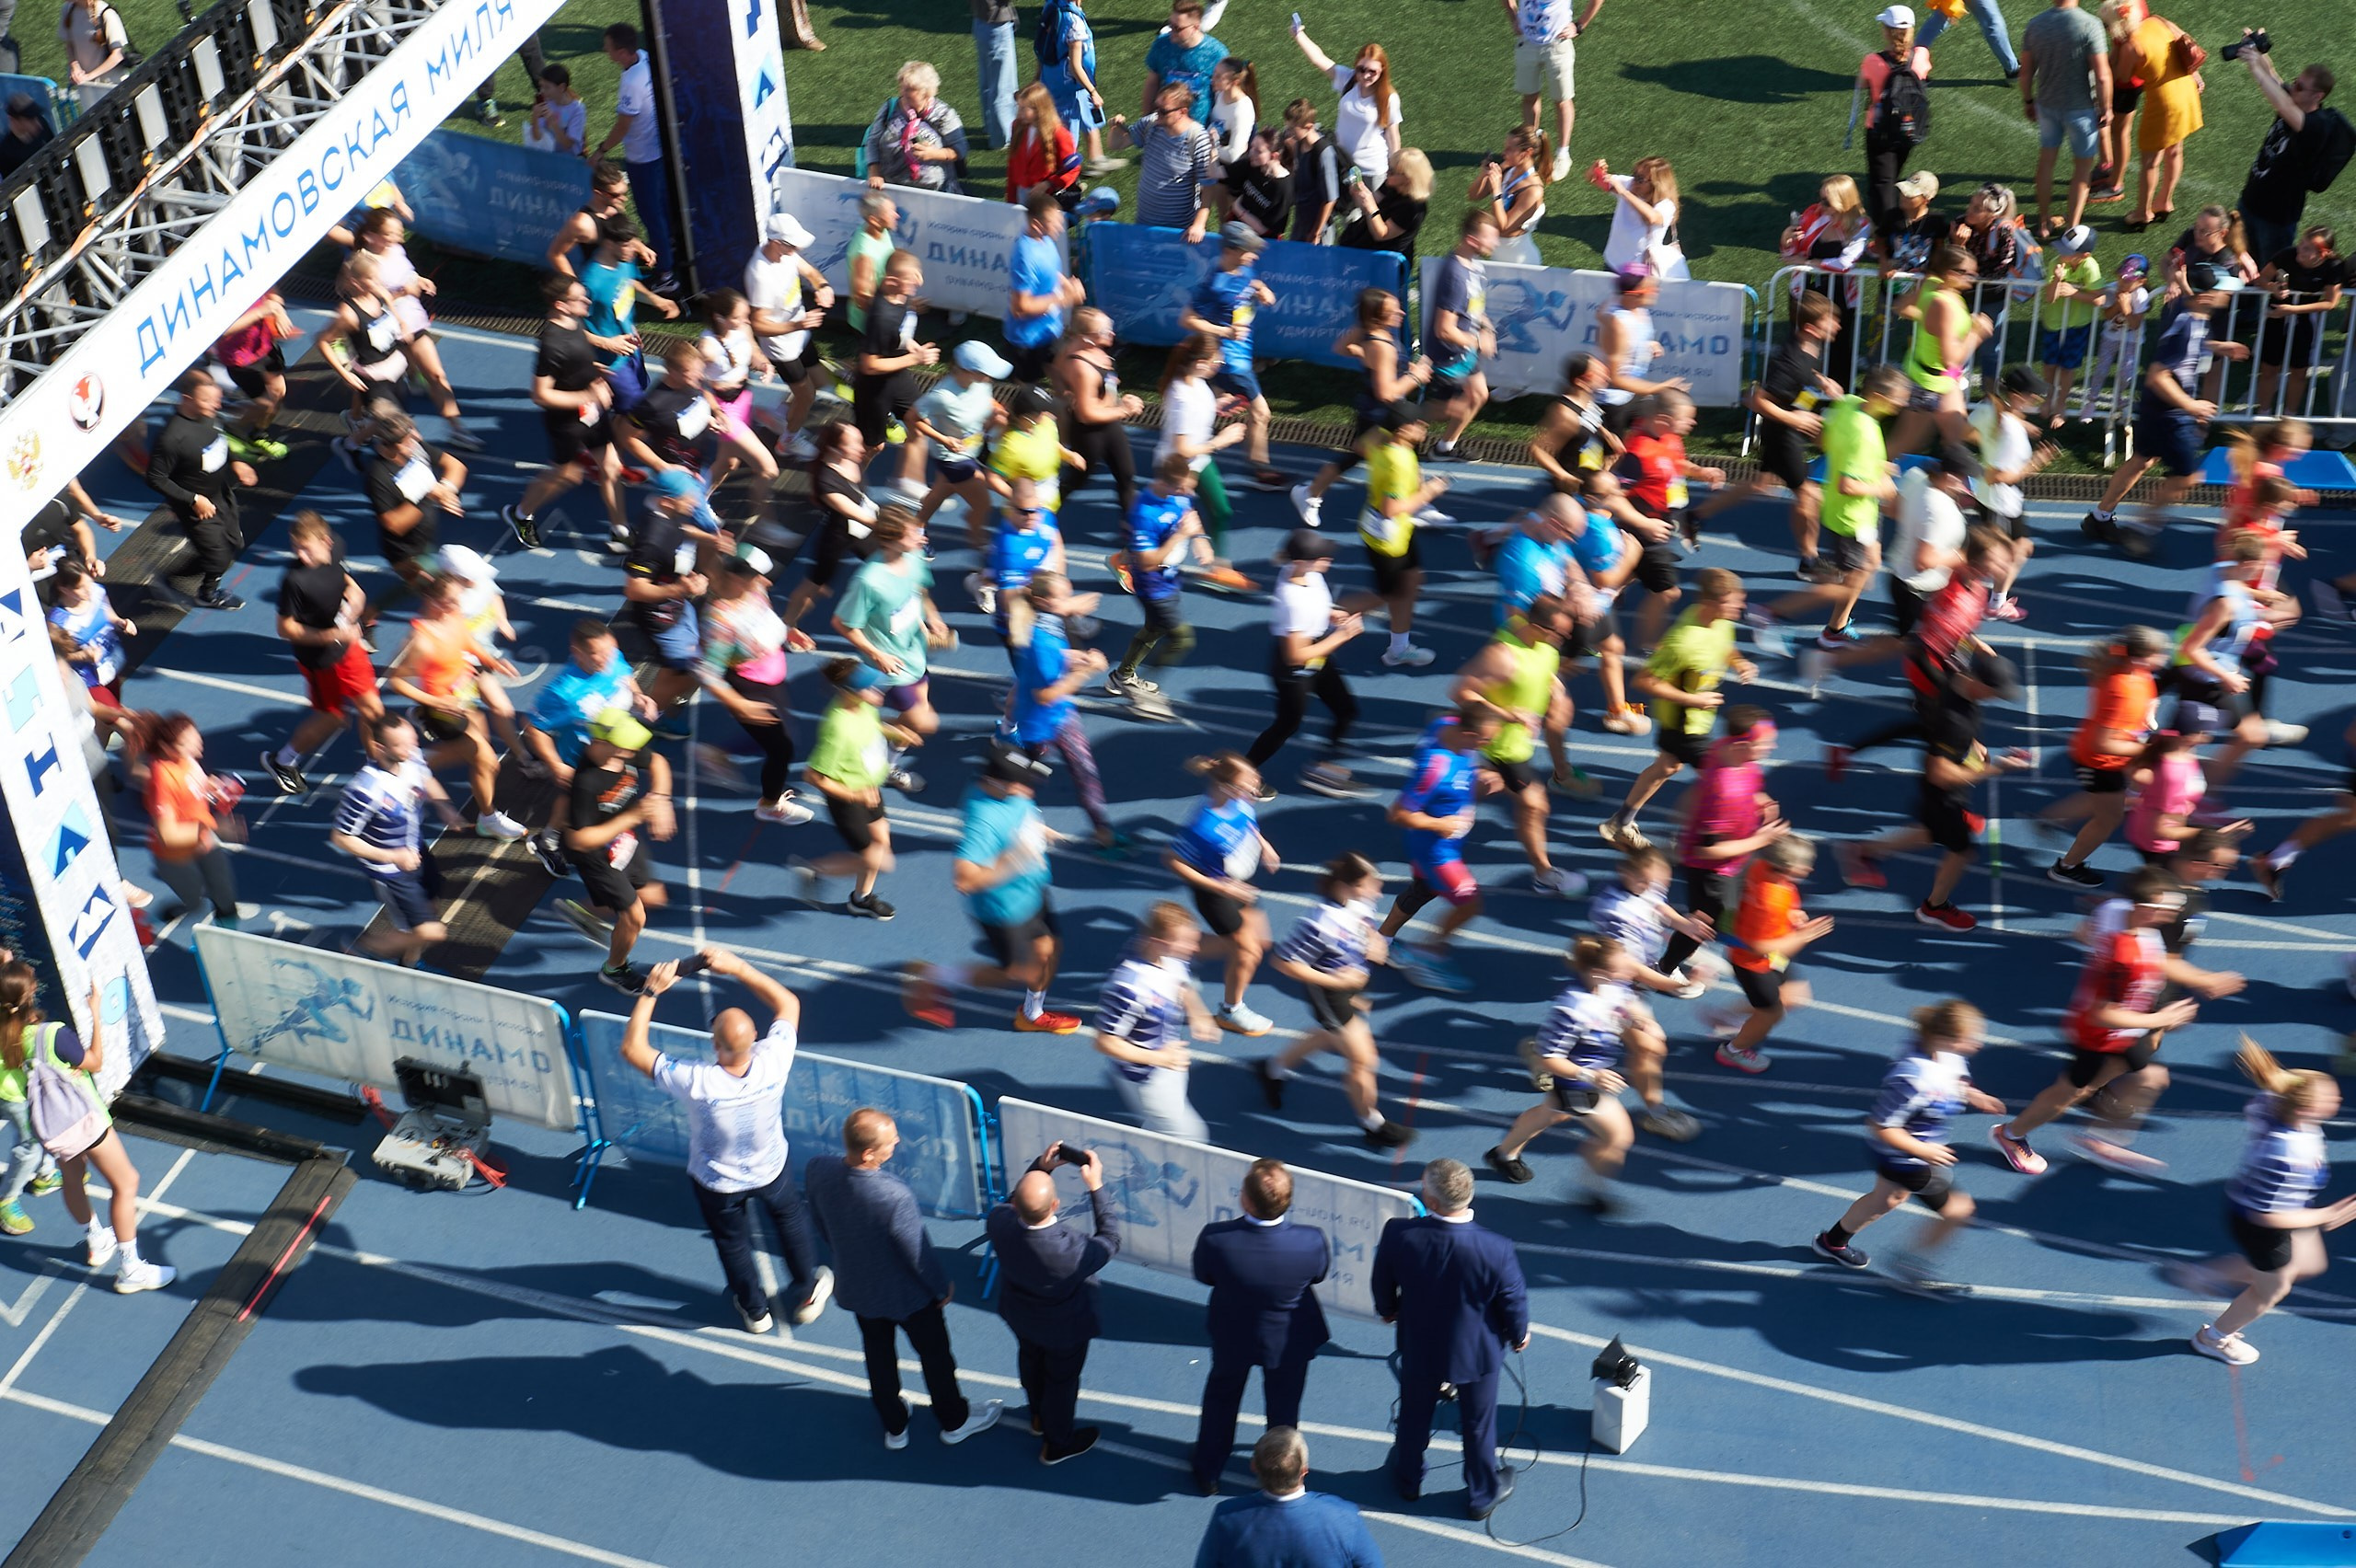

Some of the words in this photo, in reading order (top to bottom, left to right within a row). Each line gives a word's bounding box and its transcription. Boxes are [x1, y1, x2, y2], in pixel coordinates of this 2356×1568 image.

[137, 80, 411, 379] ДИНАМОВСКАЯ
[426, 0, 514, 96] МИЛЯ
[926, 241, 1009, 273] ДИНА
[1582, 324, 1731, 356] ДАМО
[390, 1017, 552, 1074] ДИНАМО
